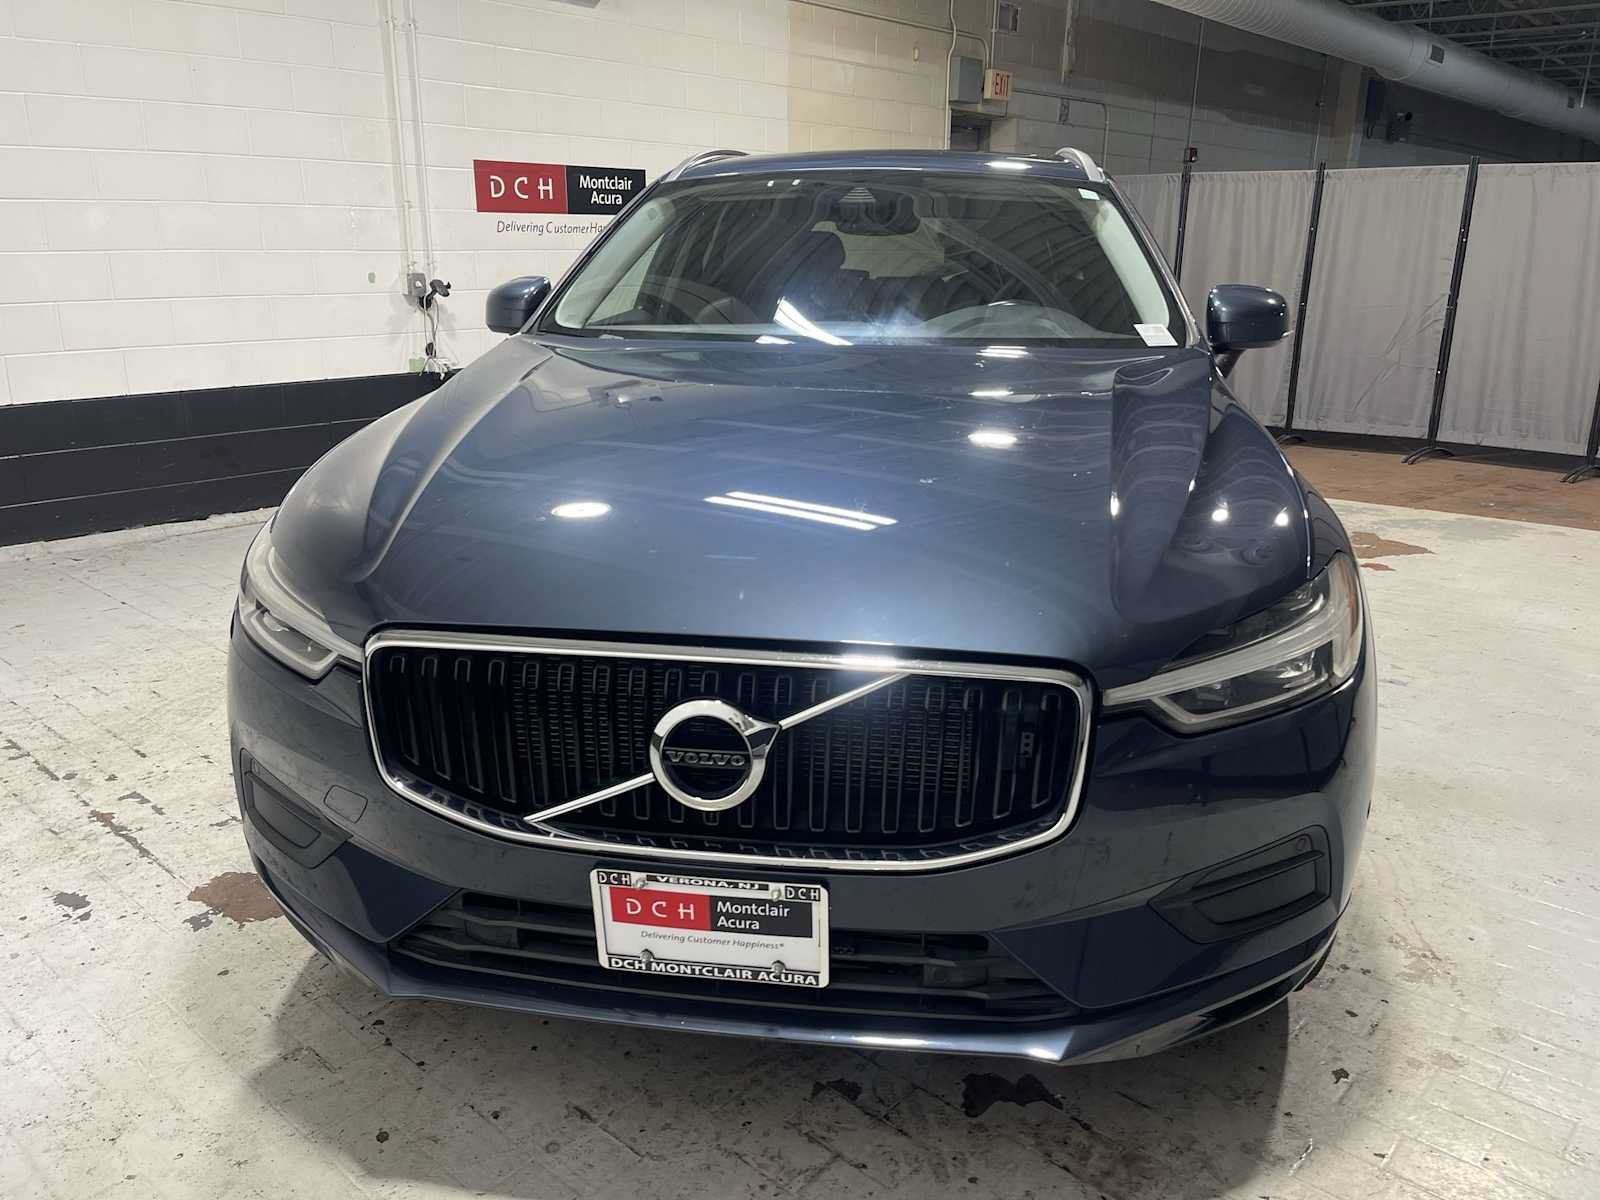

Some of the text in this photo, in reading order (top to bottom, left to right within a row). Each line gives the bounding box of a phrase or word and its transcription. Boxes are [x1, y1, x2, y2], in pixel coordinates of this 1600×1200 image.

[994, 72, 1010, 97] EXIT
[489, 175, 554, 200] DCH
[579, 175, 632, 190] Montclair
[590, 192, 622, 205] Acura
[496, 220, 544, 236] Delivering
[547, 221, 590, 234] Customer
[665, 750, 745, 766] VOLVO
[599, 872, 631, 886] DCH
[656, 875, 760, 890] VERONA, NJ
[786, 886, 819, 900] DCH
[625, 897, 695, 921] DCH
[716, 901, 791, 918] Montclair
[716, 916, 760, 930] Acura
[640, 930, 685, 944] Delivering
[687, 935, 731, 945] Customer
[610, 957, 817, 986] DCH MONTCLAIR ACURA
